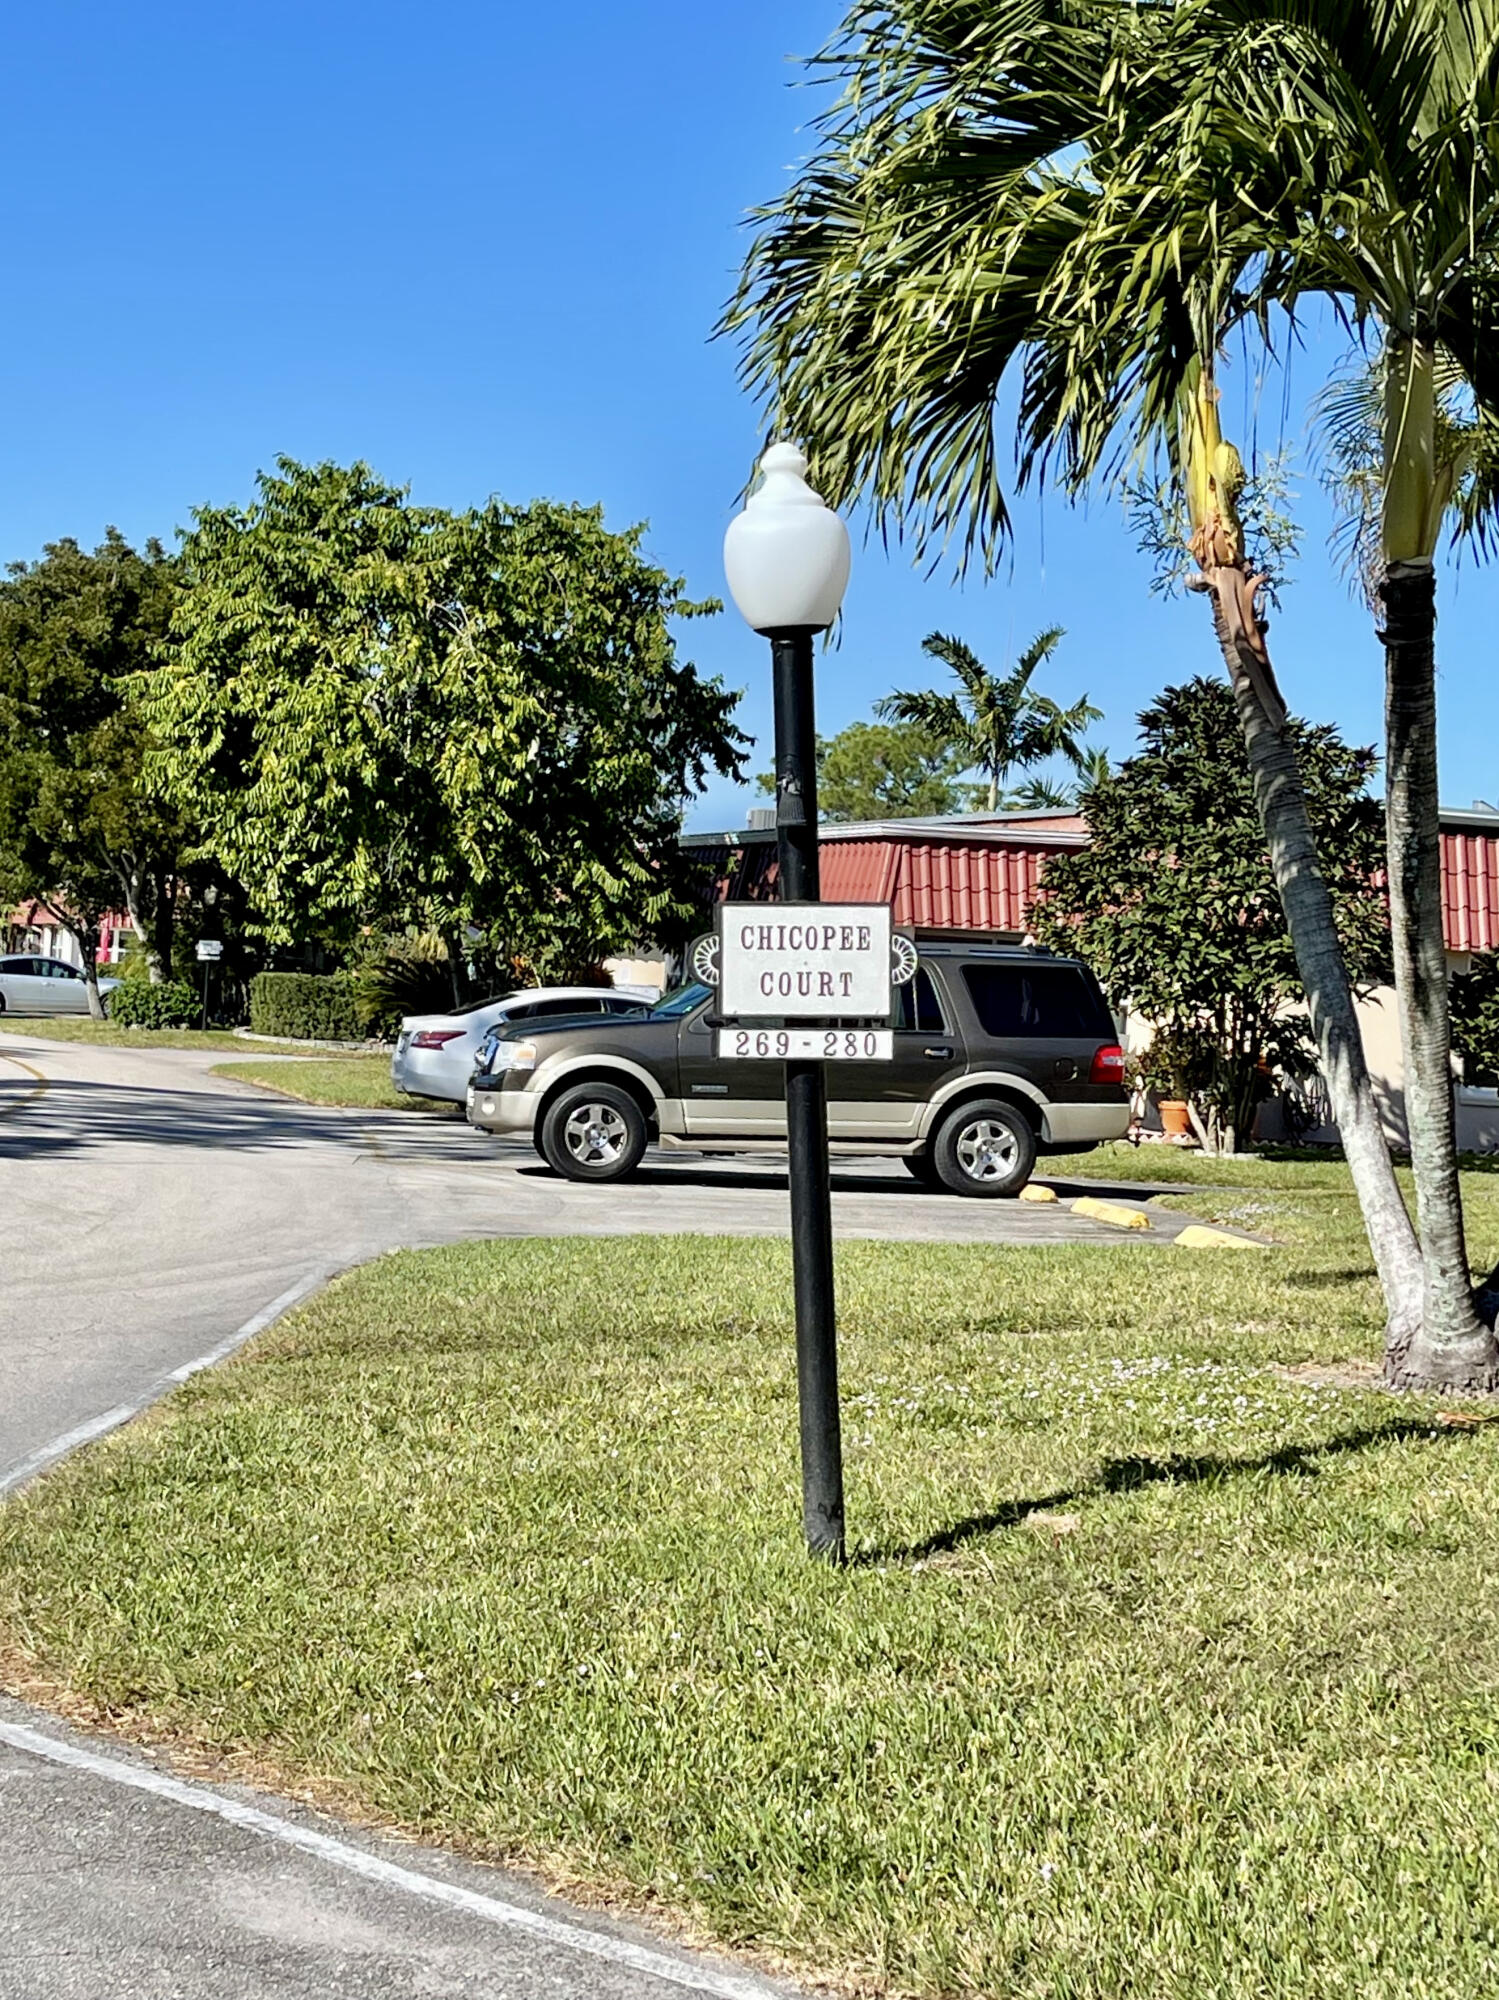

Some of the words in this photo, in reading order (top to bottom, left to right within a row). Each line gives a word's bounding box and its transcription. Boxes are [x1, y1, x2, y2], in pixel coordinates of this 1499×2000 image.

[740, 925, 871, 951] CHICOPEE
[760, 971, 853, 997] COURT
[735, 1031, 790, 1057] 269
[823, 1032, 878, 1057] 280
